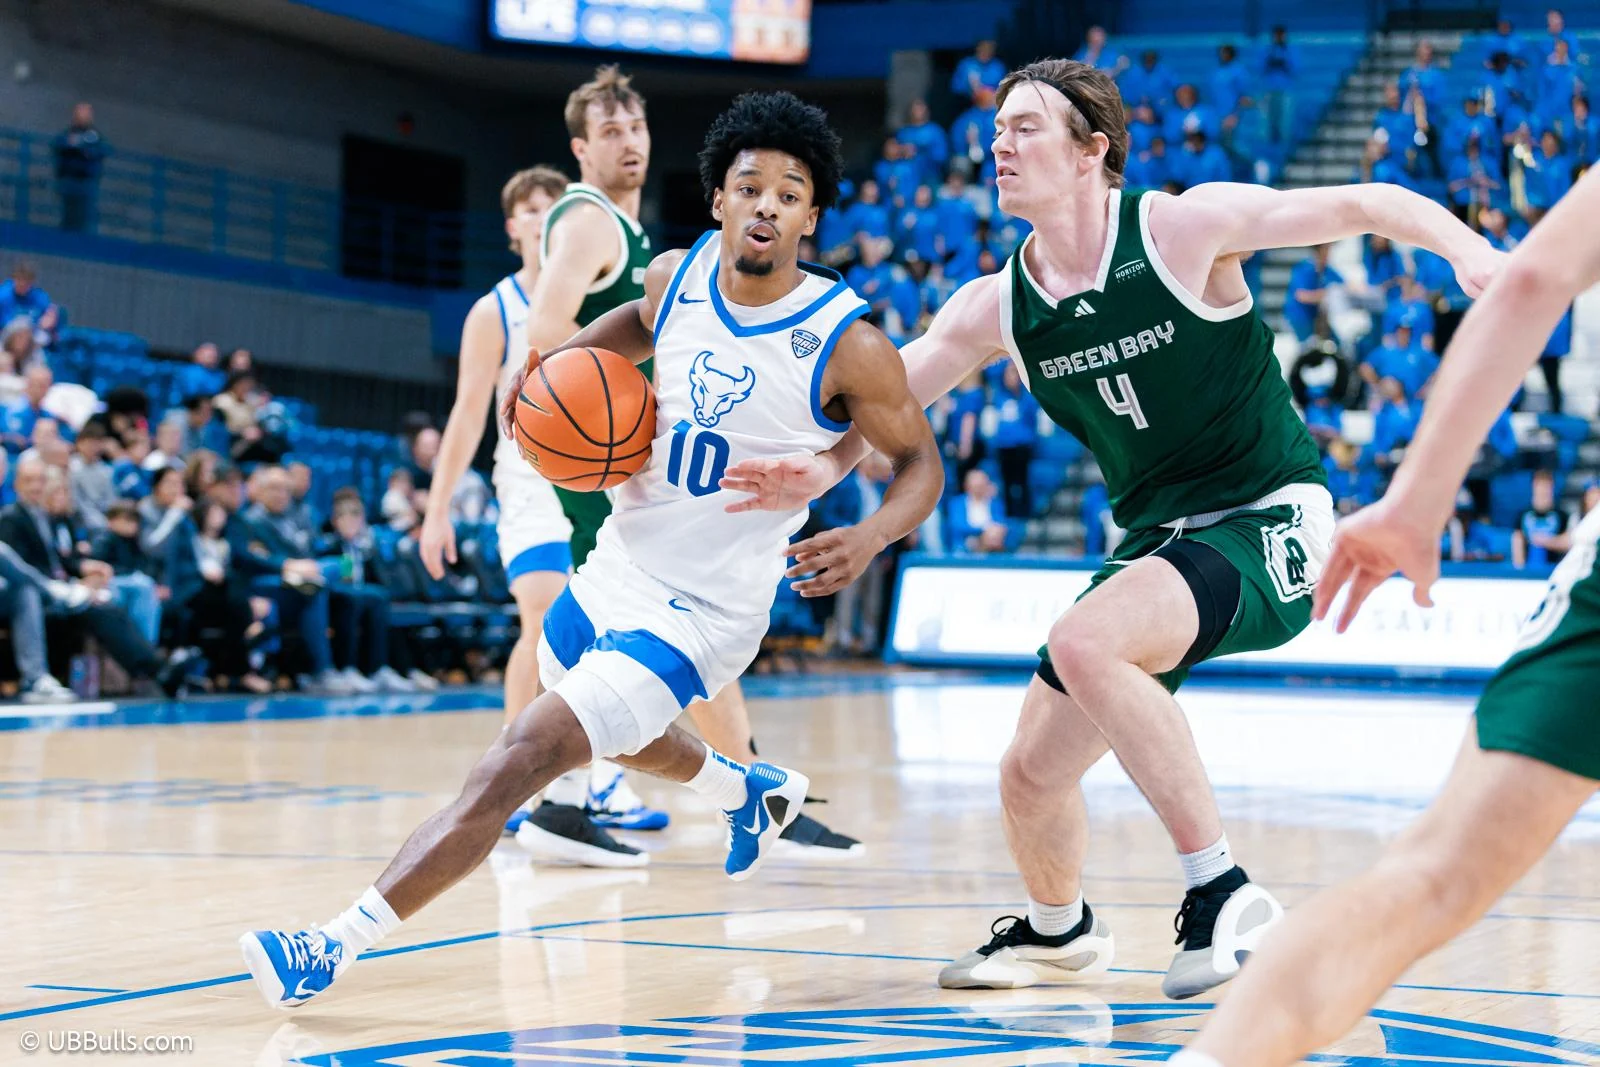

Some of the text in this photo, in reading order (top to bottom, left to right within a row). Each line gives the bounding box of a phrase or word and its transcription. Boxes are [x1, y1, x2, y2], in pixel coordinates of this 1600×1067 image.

[1115, 261, 1146, 279] HORIZON
[1039, 320, 1175, 379] GREEN BAY
[1096, 373, 1150, 430] 4
[667, 420, 730, 498] 10
